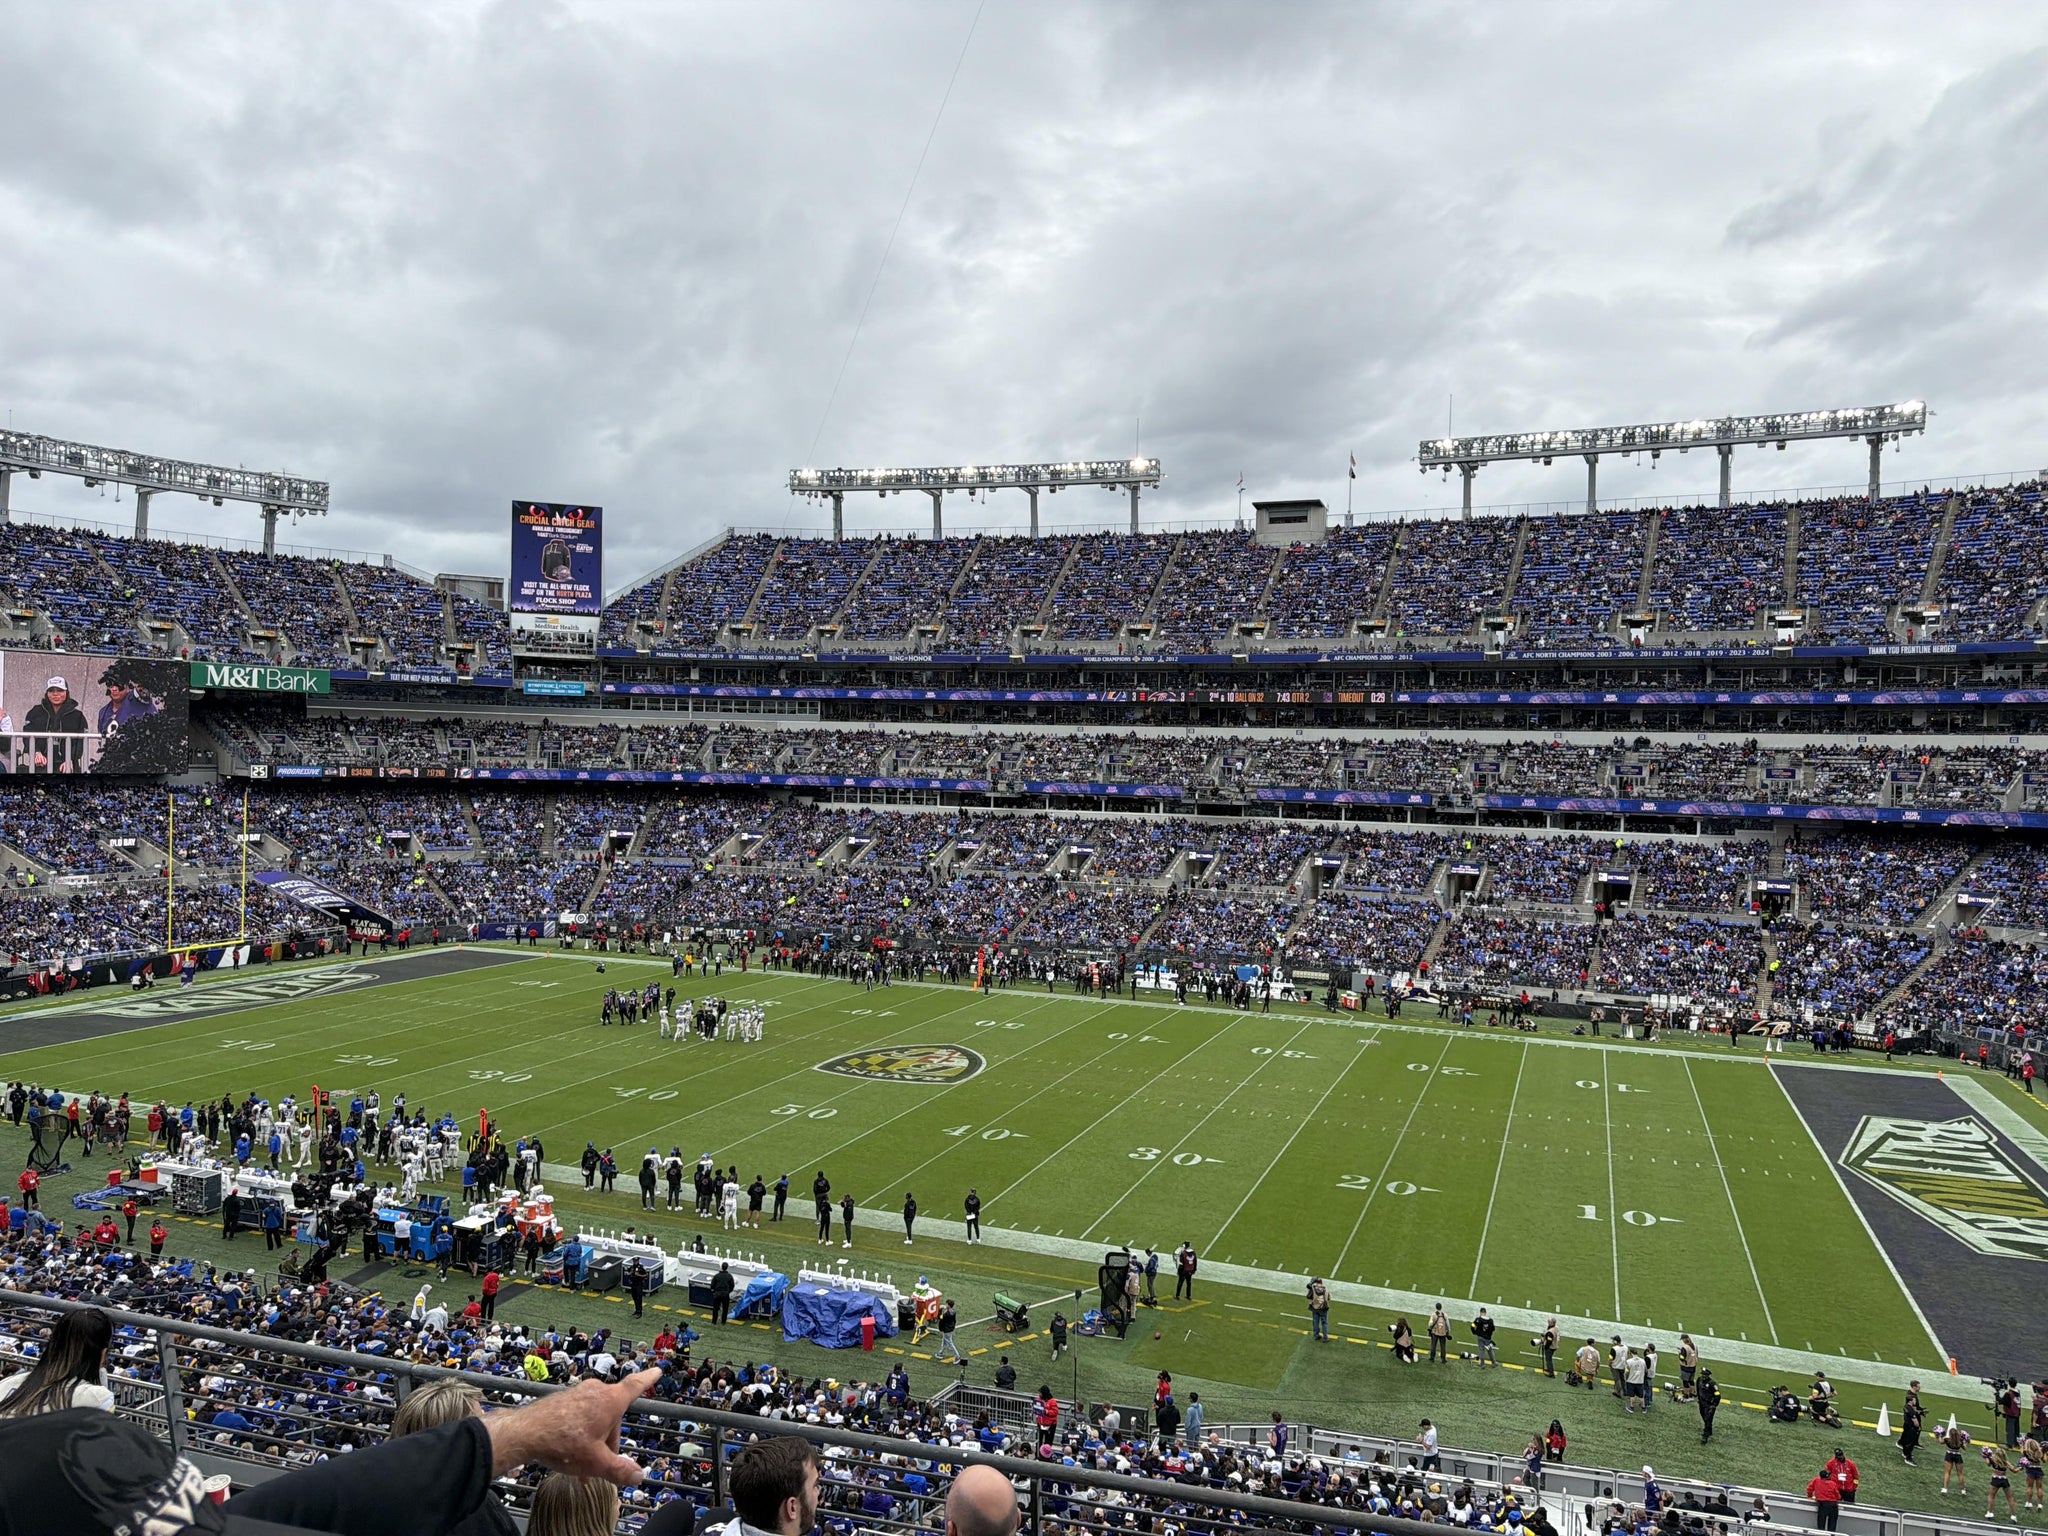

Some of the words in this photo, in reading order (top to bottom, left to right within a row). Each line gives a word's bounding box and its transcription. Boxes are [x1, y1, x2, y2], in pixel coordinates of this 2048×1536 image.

[520, 515, 549, 526] CRUCIAL
[552, 517, 574, 528] CATCH
[576, 519, 595, 529] GEAR
[523, 581, 538, 589] VISIT
[539, 582, 549, 590] THE
[574, 584, 590, 592] FLOCK
[520, 588, 535, 596] SHOP
[575, 591, 592, 599] PLAZA
[1868, 646, 1887, 654] THANK
[1888, 646, 1900, 654] YOU
[1901, 645, 1931, 654] FRONTLINE
[1932, 645, 1957, 653] HEROES!
[206, 665, 264, 689] M&T
[266, 668, 318, 692] Bank
[1132, 692, 1136, 702] 3
[1180, 692, 1185, 702] 3
[1227, 692, 1234, 702] 10
[1235, 692, 1248, 702] BALL
[1248, 692, 1256, 702] ON
[1256, 692, 1264, 702] 32
[1276, 692, 1290, 702] 7:43
[1292, 692, 1304, 703] QTR
[1304, 692, 1310, 702] 2
[1338, 692, 1365, 703] TIMEOUT
[1370, 692, 1386, 703] 0:29
[253, 766, 265, 776] 25
[277, 768, 320, 776] PROGRESSIVE
[339, 766, 347, 777] 10
[379, 767, 384, 777] 6
[414, 768, 418, 777] 9
[454, 768, 458, 777] 7
[110, 839, 122, 848] OLD
[124, 838, 136, 847] BAY
[350, 918, 369, 927] PLAY
[354, 926, 386, 937] RAVEN
[98, 968, 378, 1017] RAVENS
[770, 1104, 838, 1119] 50
[278, 1126, 286, 1134] 71
[942, 1124, 1010, 1140] 40
[1128, 1147, 1202, 1166] 30
[1336, 1174, 1417, 1196] 20
[726, 1190, 736, 1198] 47
[1576, 1204, 1657, 1226] 10
